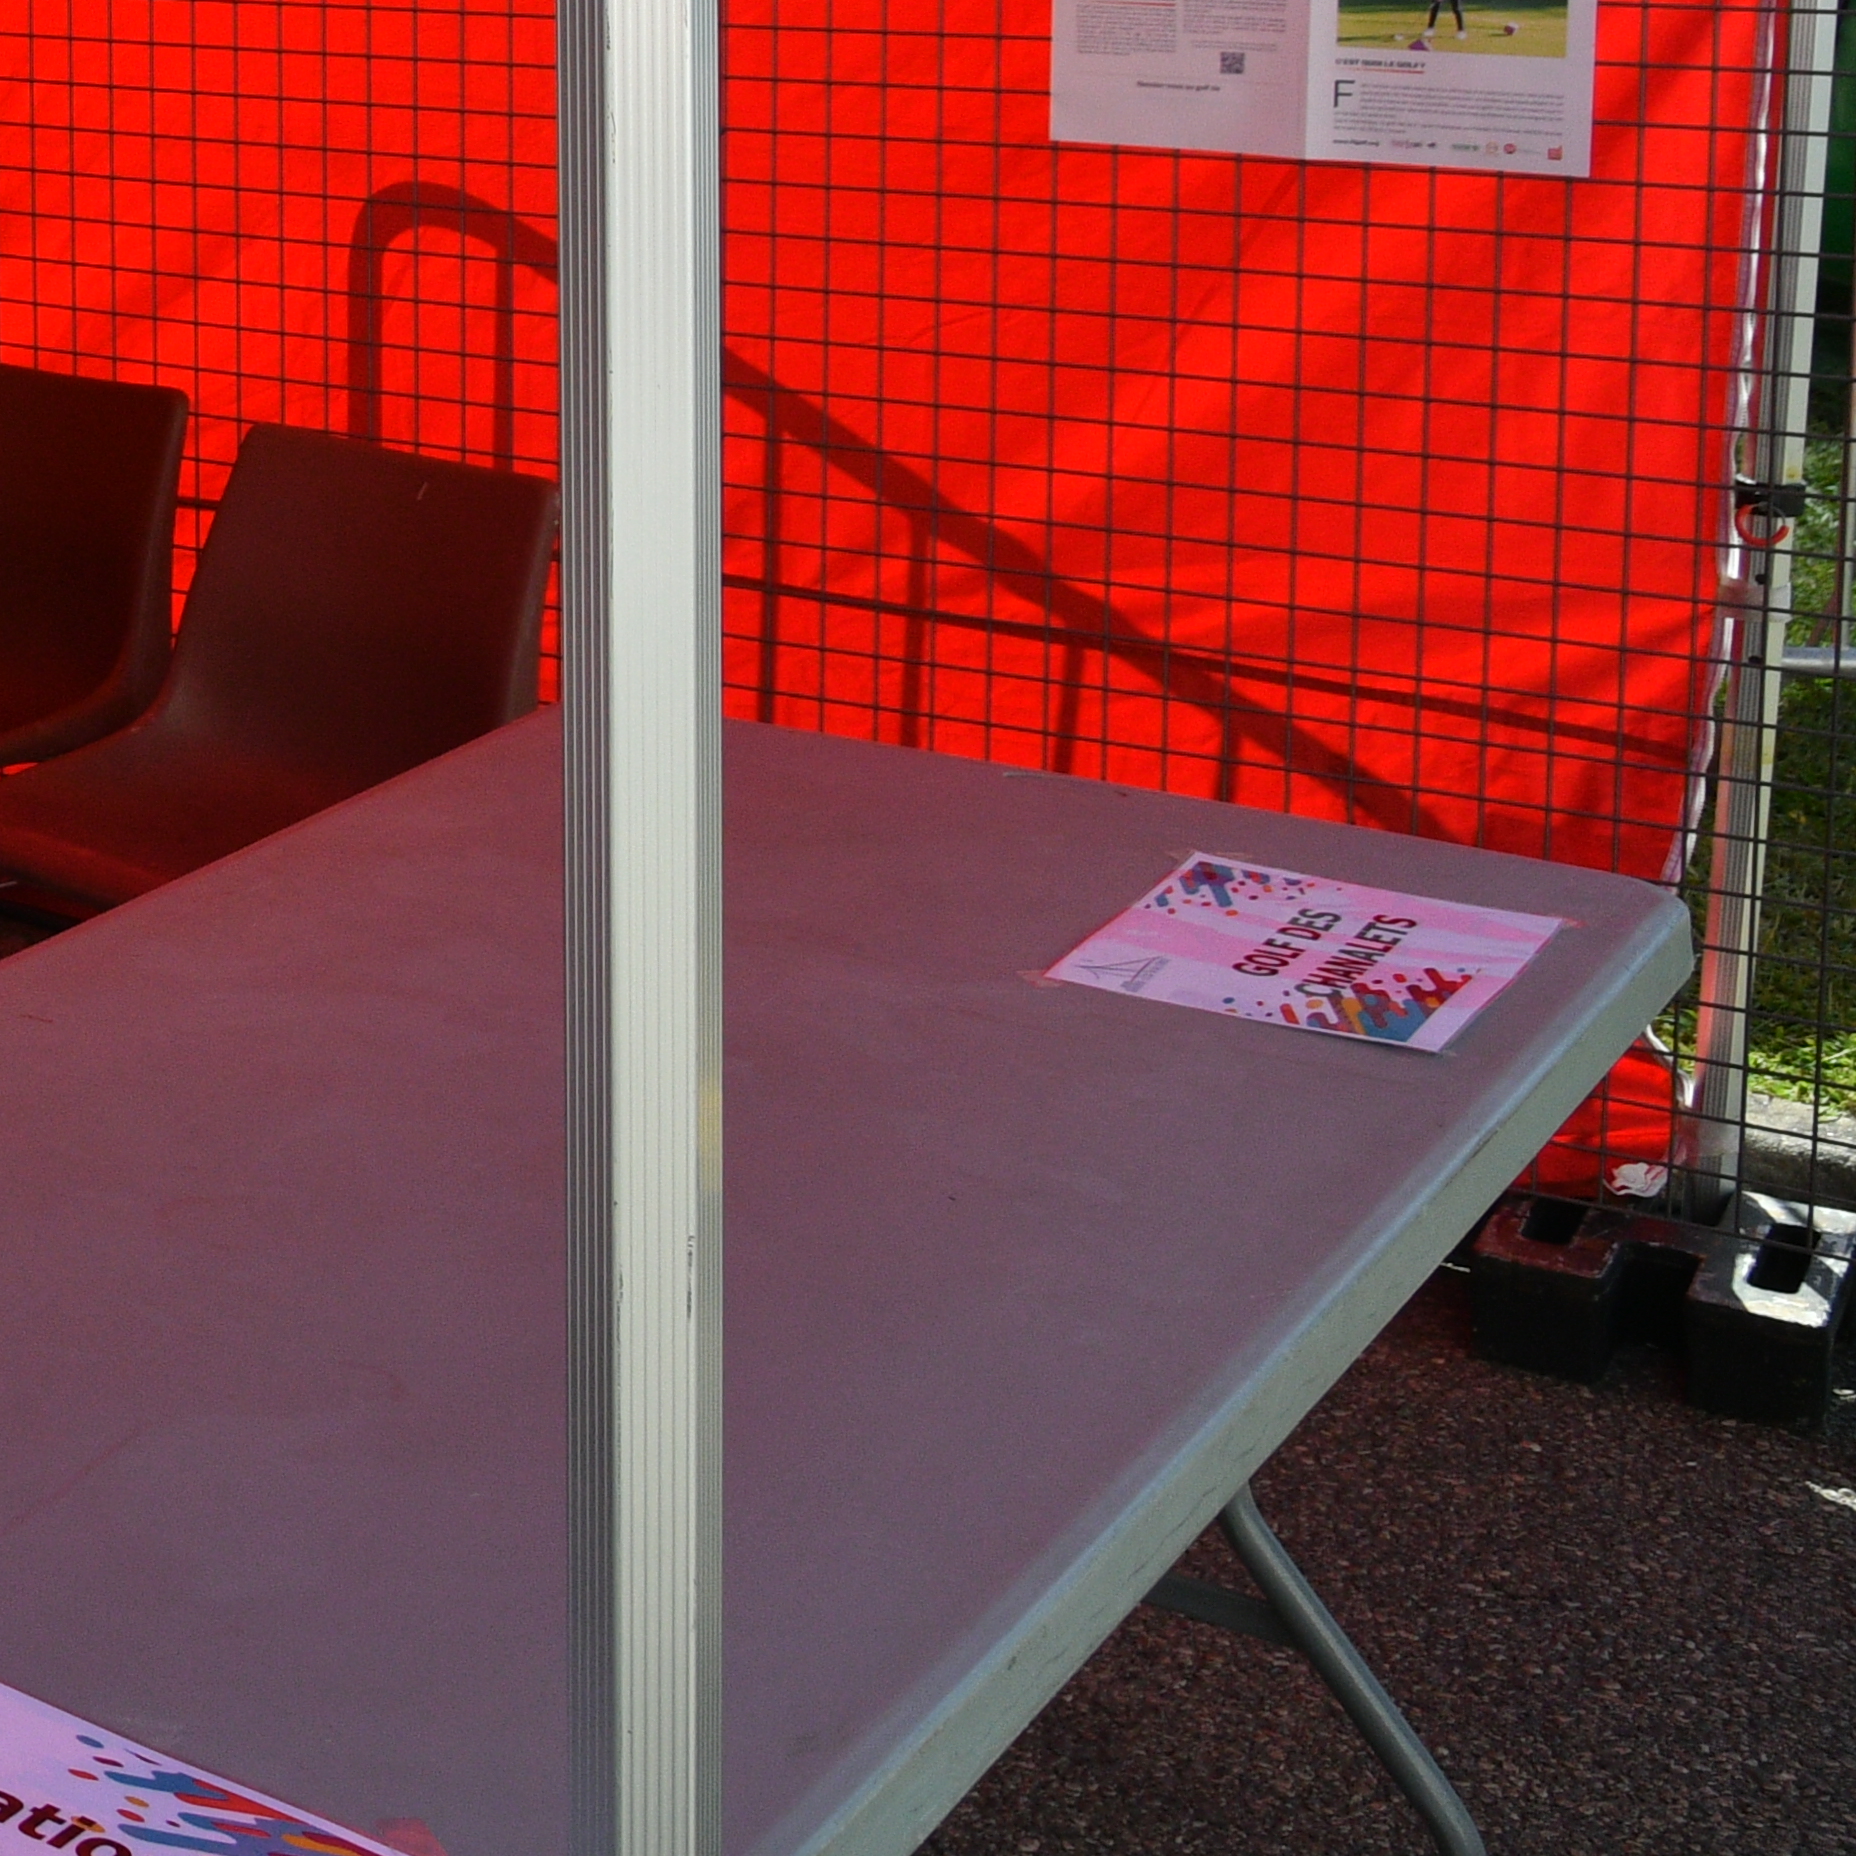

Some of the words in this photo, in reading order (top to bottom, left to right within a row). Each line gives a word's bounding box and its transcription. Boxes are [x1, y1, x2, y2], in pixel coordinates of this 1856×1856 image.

[1232, 938, 1306, 977] GOLF
[1276, 908, 1342, 941] DES
[1294, 914, 1417, 998] CHANALETS
